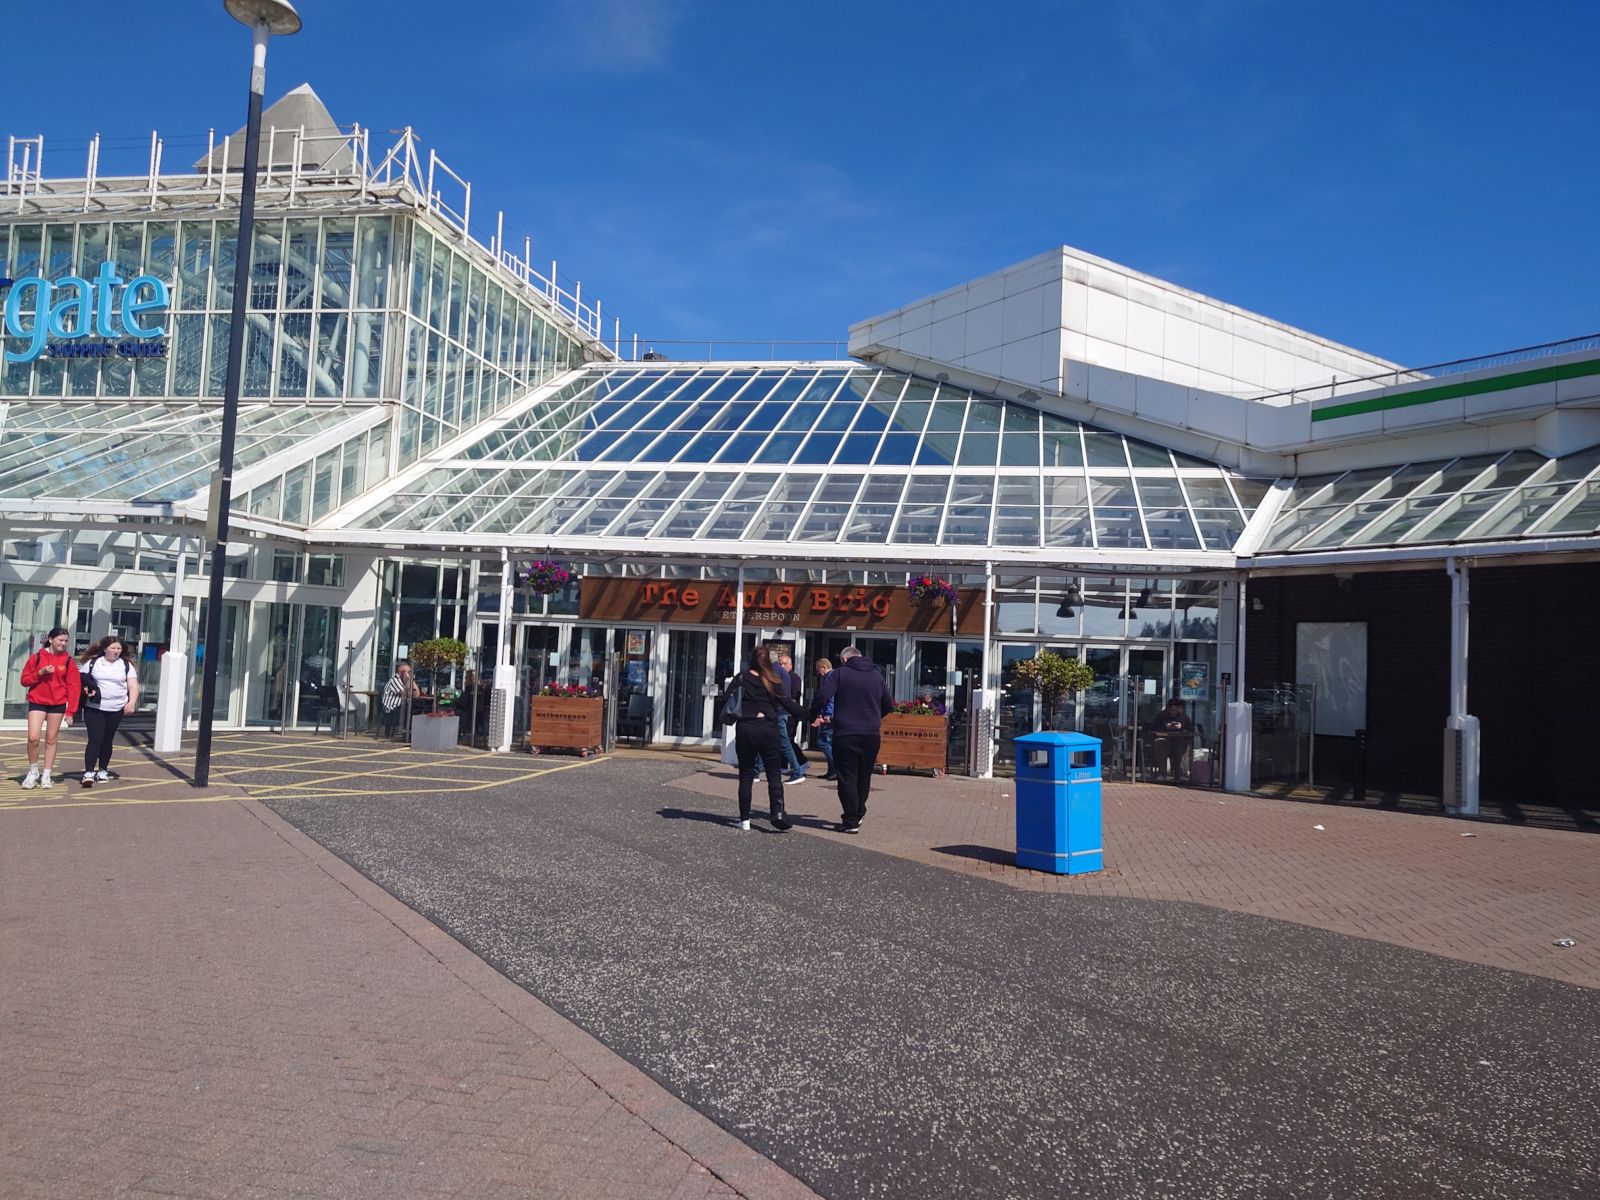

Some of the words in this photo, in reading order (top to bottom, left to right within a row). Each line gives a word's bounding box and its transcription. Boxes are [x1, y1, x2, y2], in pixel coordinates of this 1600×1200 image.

[0, 261, 170, 362] gate
[640, 583, 700, 606] The
[717, 585, 795, 609] Auld
[811, 588, 891, 618] Brig
[713, 610, 801, 621] WETERSPOON
[884, 730, 939, 738] wetherspoon
